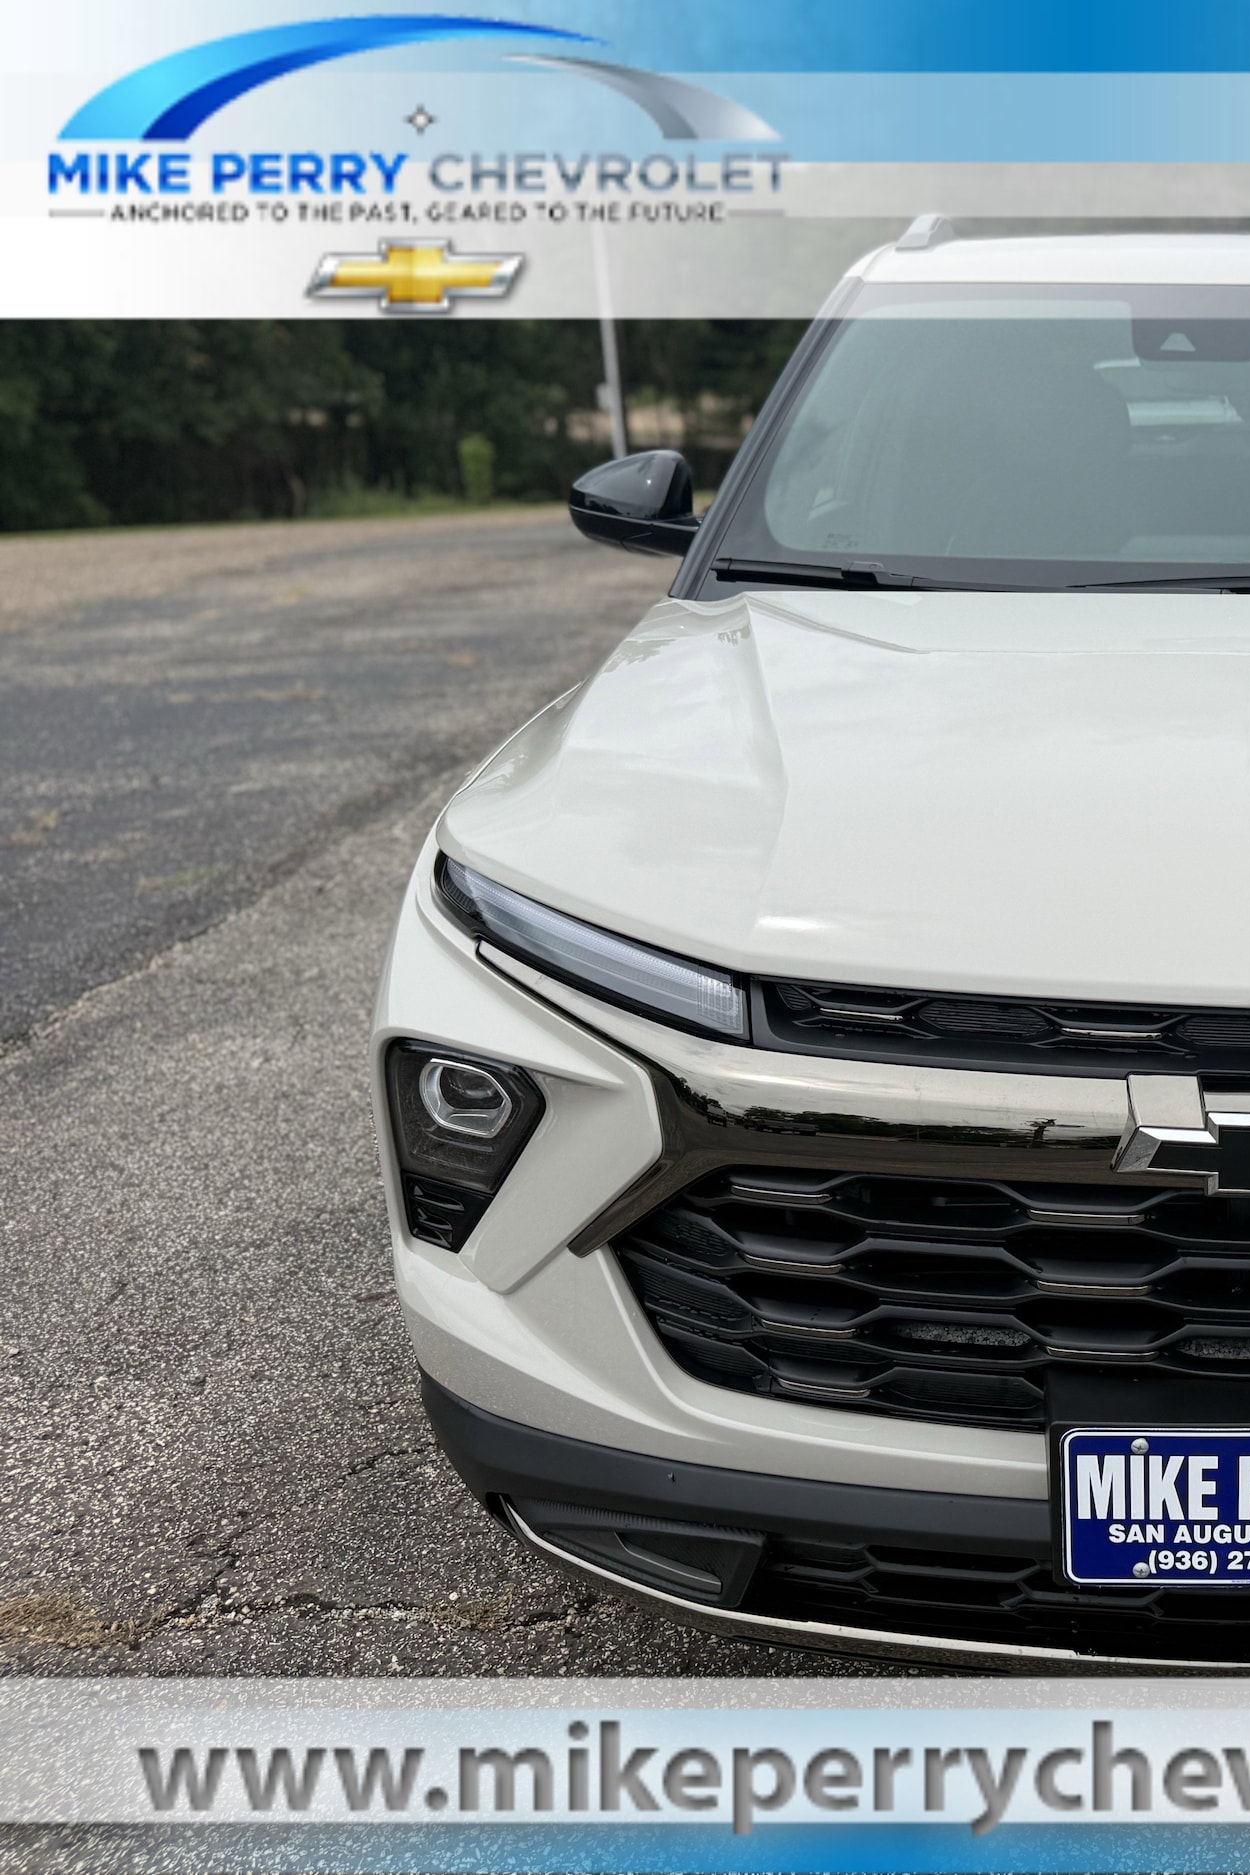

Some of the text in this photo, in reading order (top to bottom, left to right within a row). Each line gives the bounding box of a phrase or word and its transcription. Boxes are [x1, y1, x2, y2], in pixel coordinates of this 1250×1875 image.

[1076, 1454, 1219, 1520] MIKE
[1108, 1524, 1165, 1544] SAN
[1148, 1550, 1218, 1575] (936)
